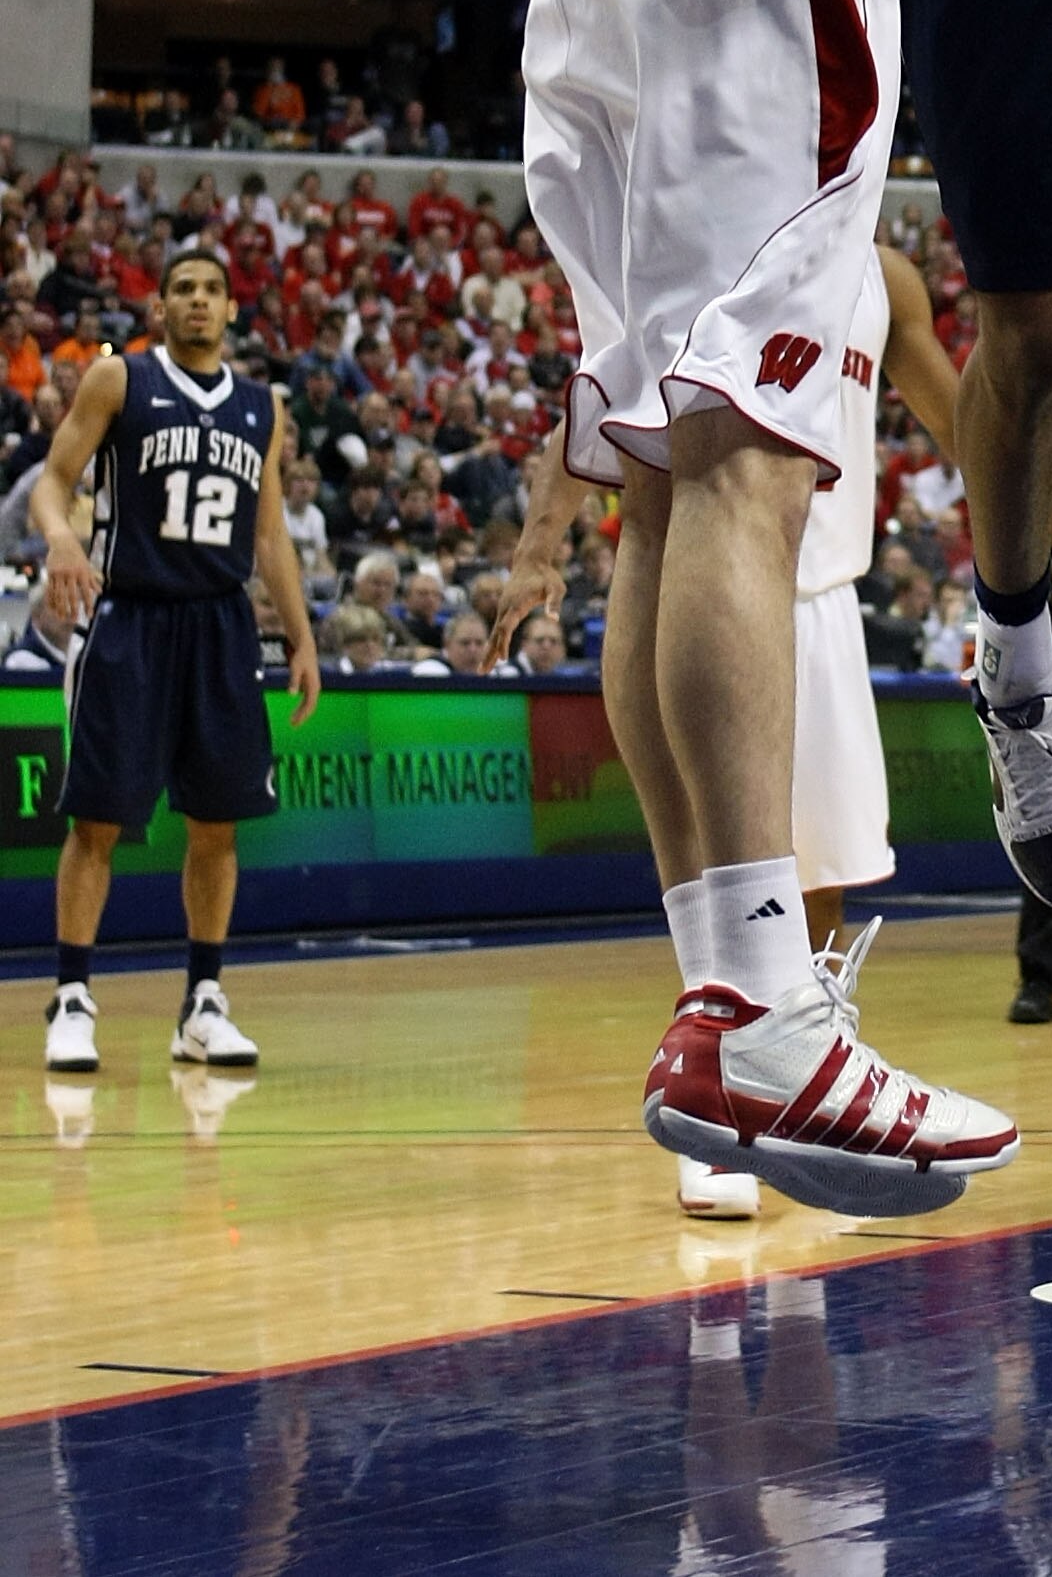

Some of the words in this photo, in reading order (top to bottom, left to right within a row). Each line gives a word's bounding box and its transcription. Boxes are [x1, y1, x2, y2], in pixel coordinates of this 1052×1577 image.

[138, 426, 200, 475] PENN
[208, 429, 262, 492] STATE
[160, 470, 238, 546] 12
[16, 753, 48, 818] F
